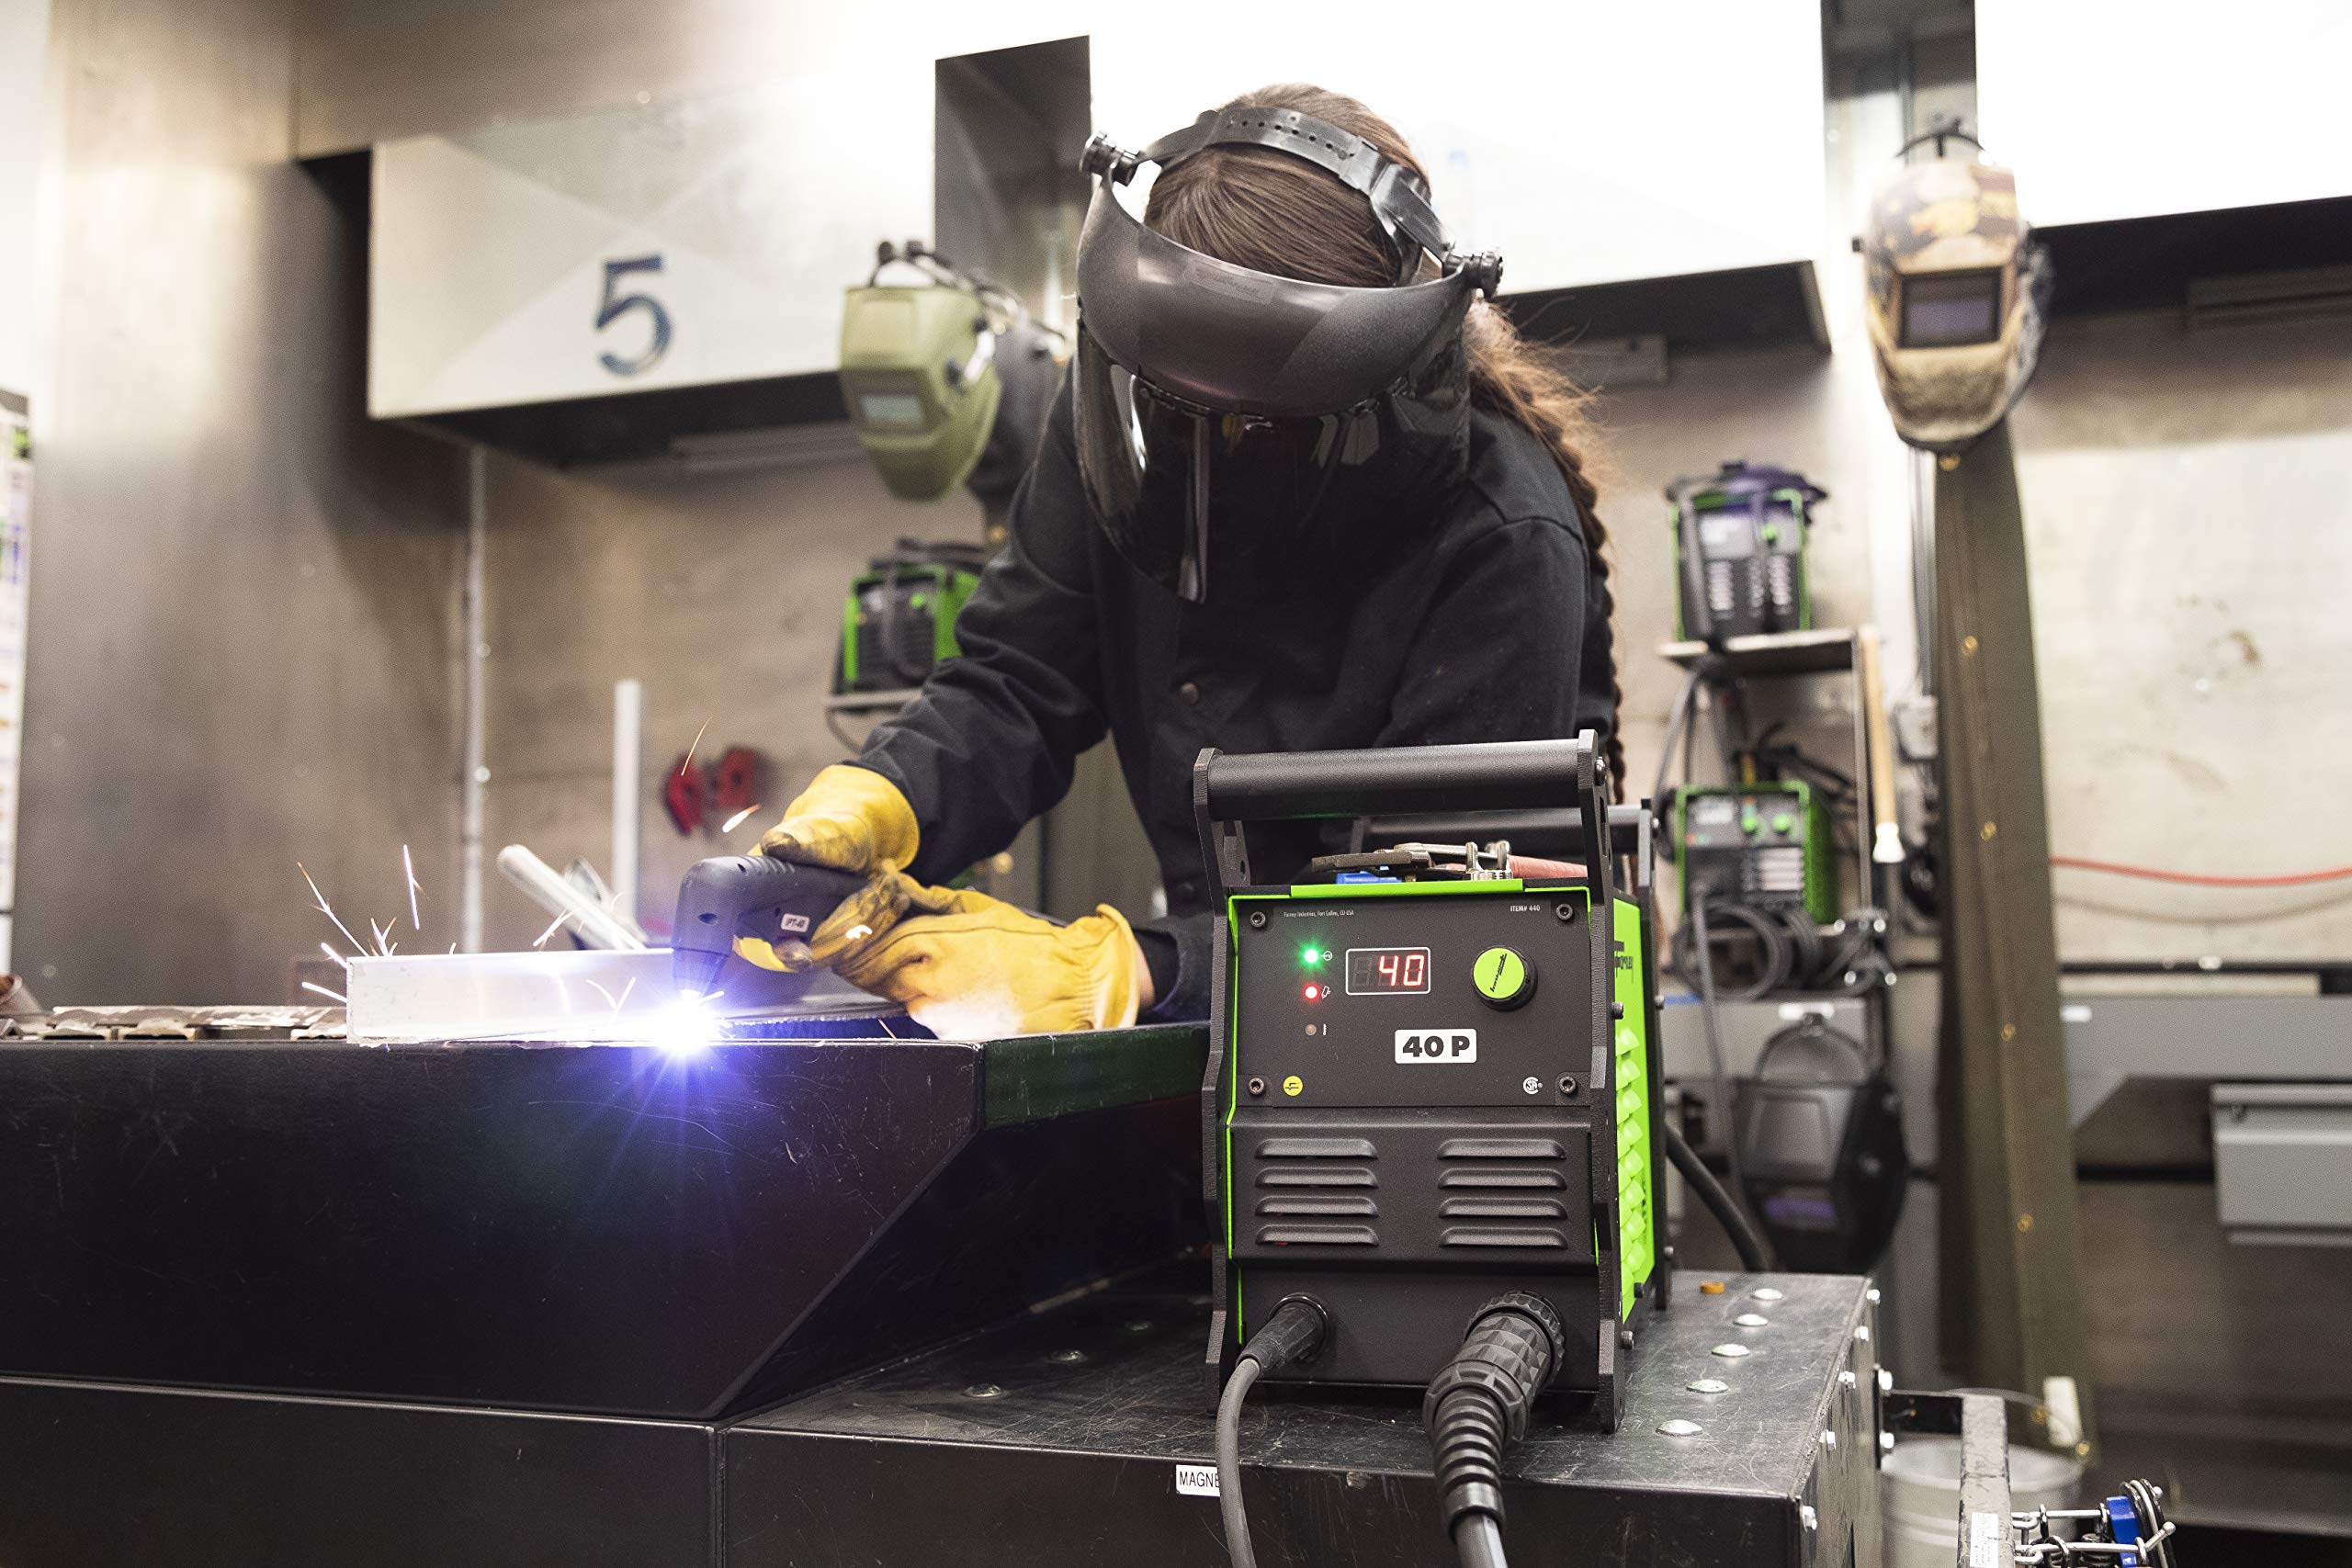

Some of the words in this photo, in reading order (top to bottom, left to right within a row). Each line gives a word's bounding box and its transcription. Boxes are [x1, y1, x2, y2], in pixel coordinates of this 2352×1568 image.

[597, 255, 671, 375] 5
[1529, 904, 1541, 912] 440
[1379, 954, 1425, 987] 40
[1402, 1035, 1444, 1057] 40
[1452, 1035, 1470, 1057] P
